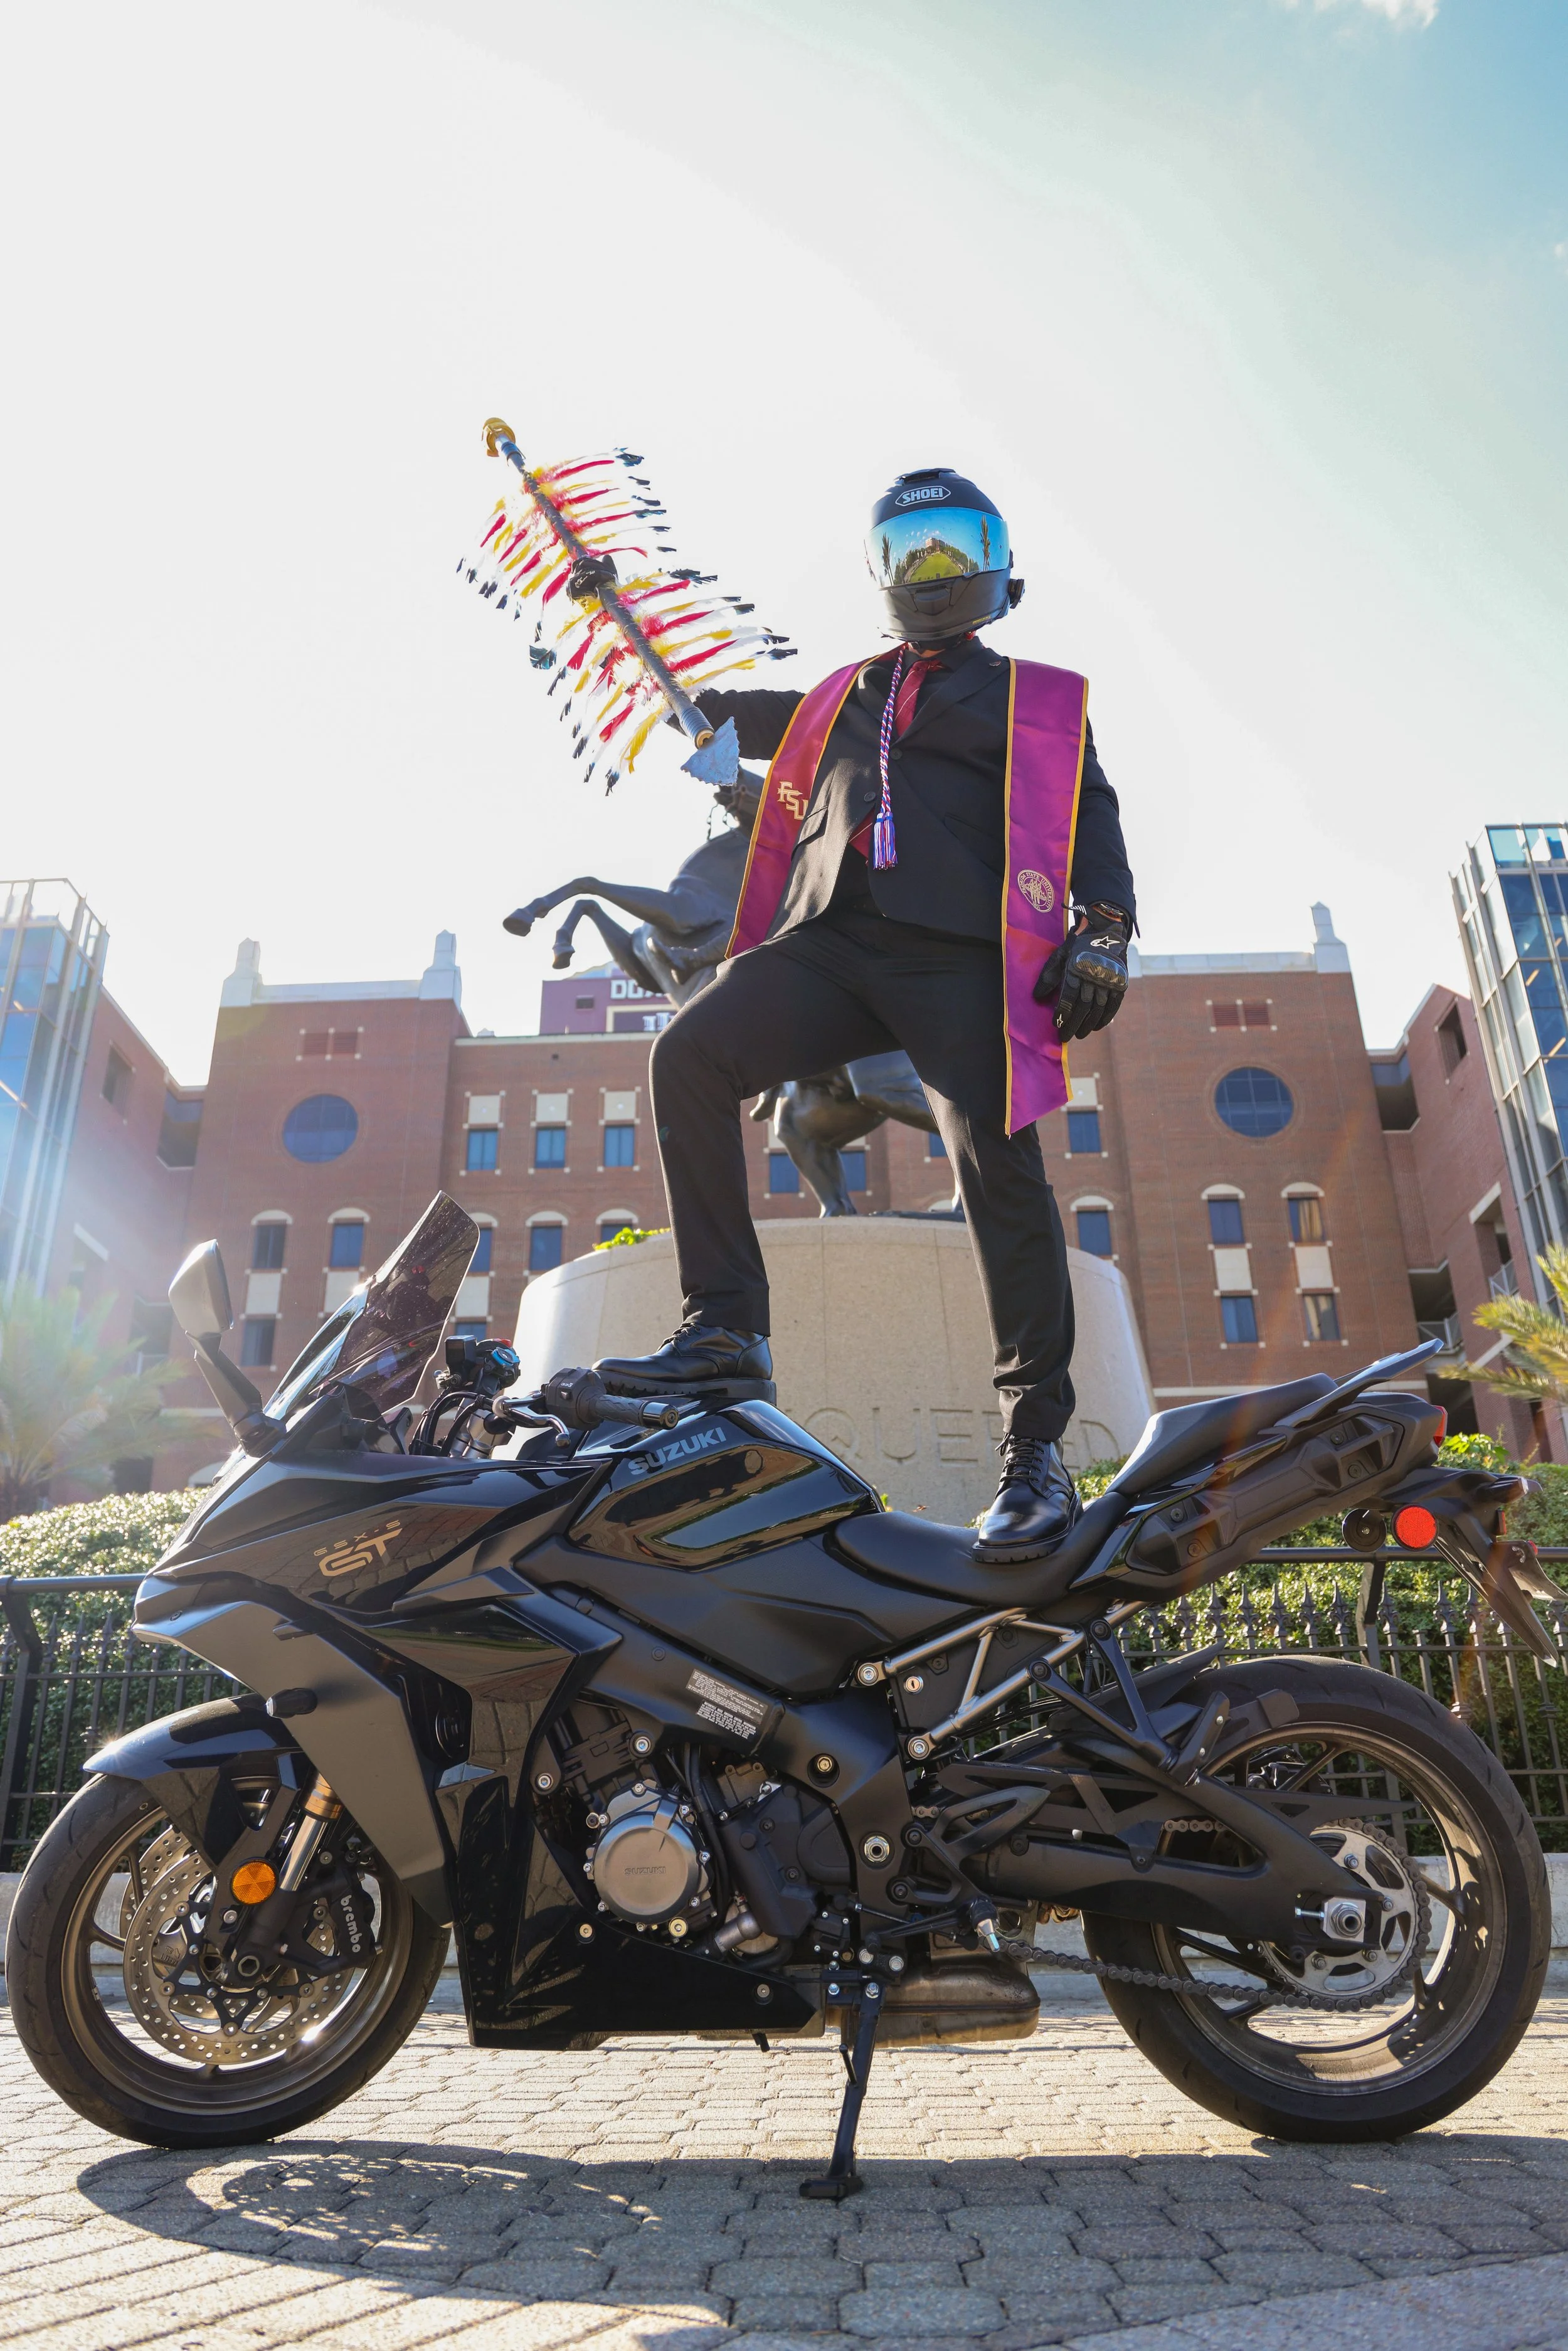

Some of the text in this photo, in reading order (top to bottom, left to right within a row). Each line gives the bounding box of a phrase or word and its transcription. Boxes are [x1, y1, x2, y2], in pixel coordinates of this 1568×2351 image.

[902, 487, 943, 504] SHOEI
[777, 781, 808, 820] FSU
[1025, 872, 1040, 880] STATE
[1041, 878, 1052, 908] UNIVERSITY
[628, 1427, 726, 1475] SUZUKI
[314, 1520, 400, 1556] GSX-S
[319, 1528, 403, 1576] GT
[625, 1866, 666, 1876] SUZUKI
[341, 1895, 363, 1953] brembo
